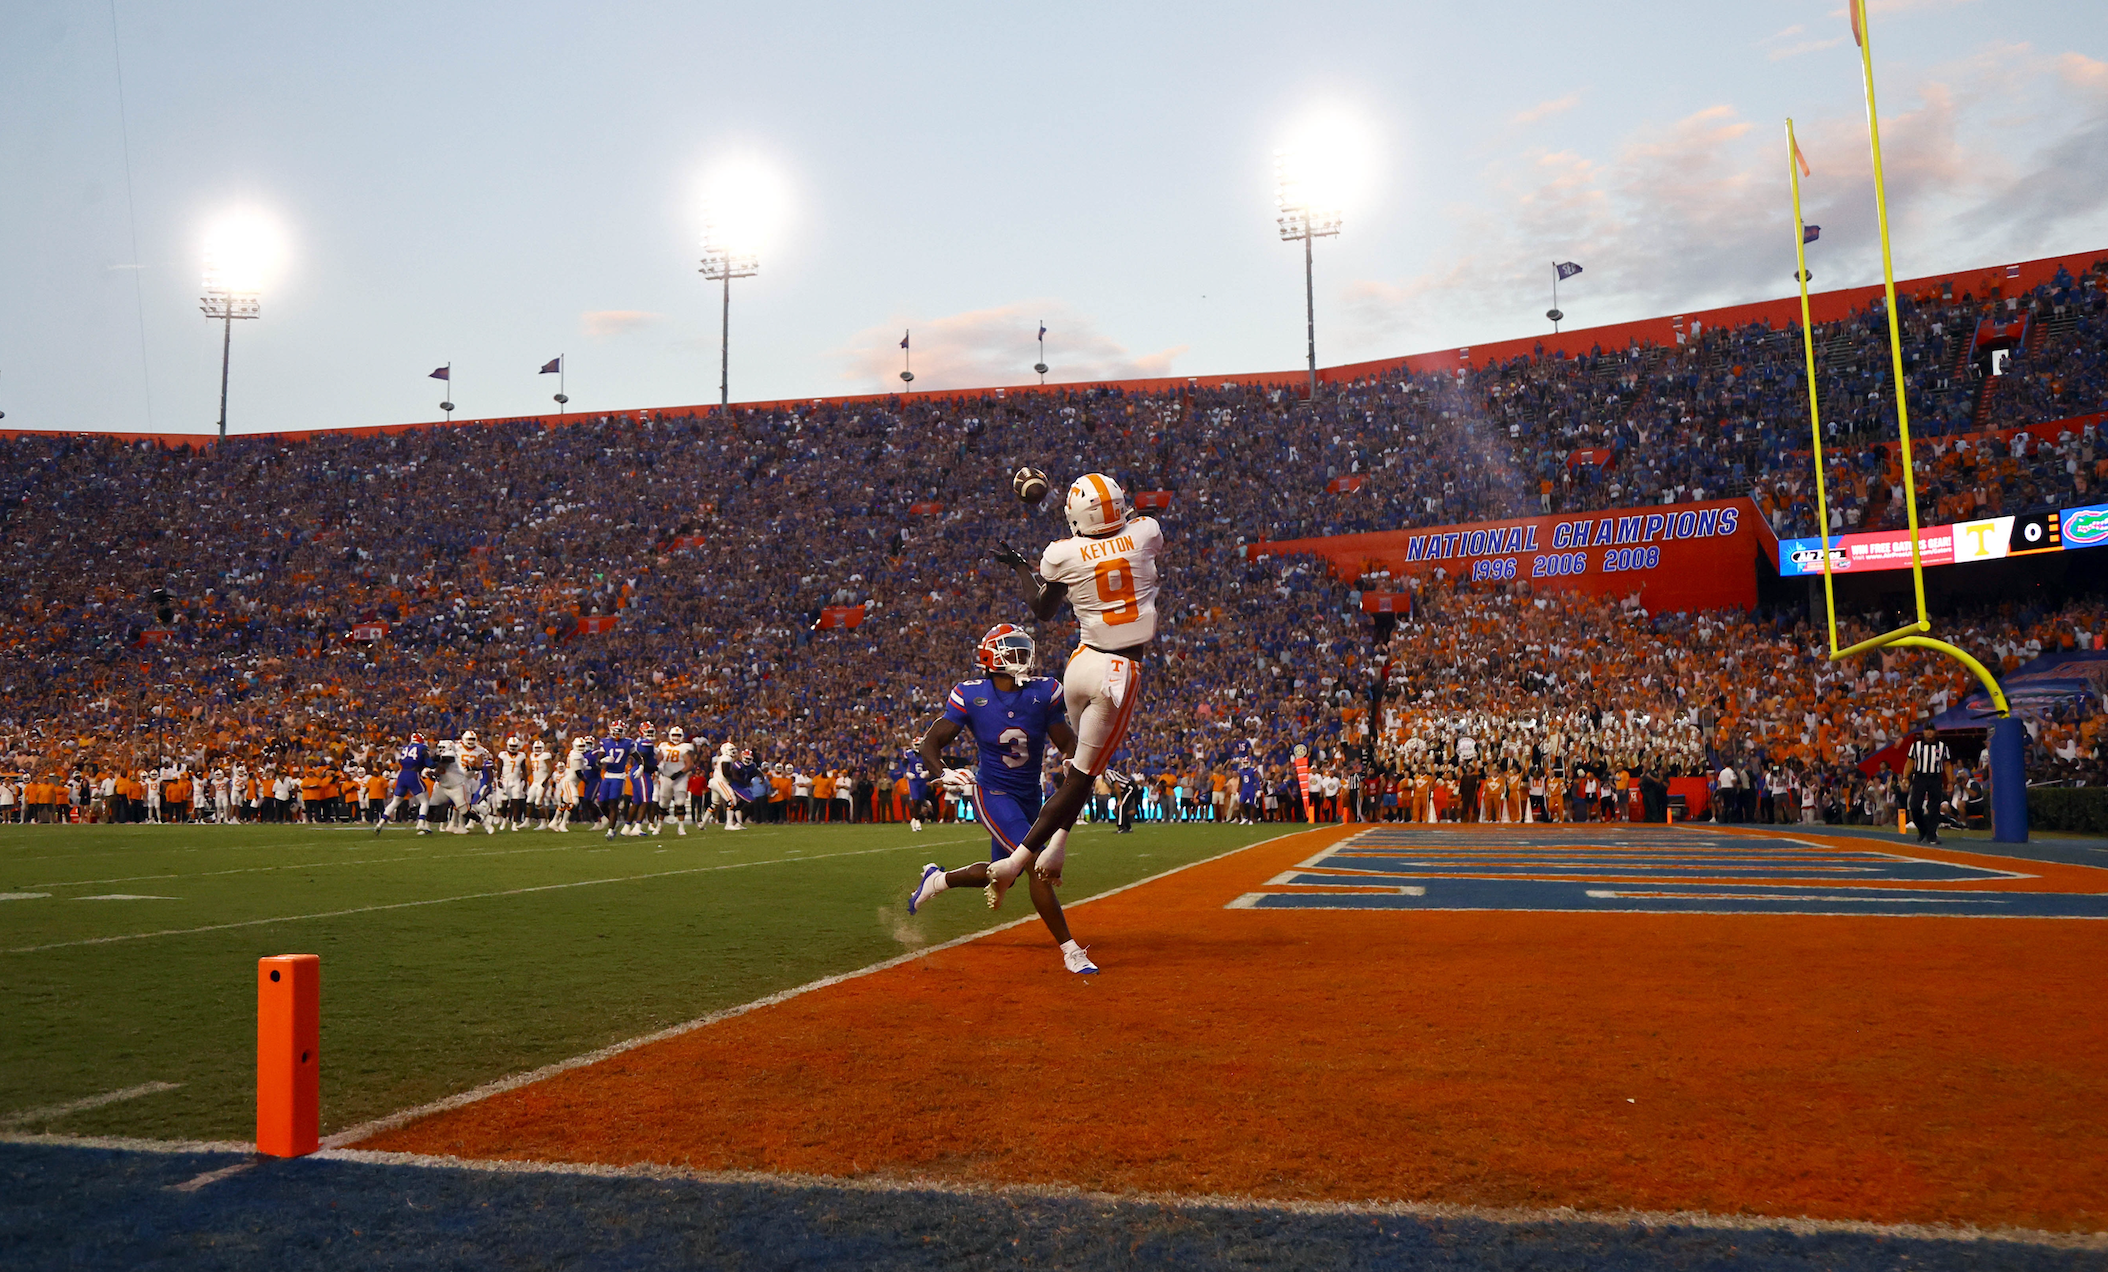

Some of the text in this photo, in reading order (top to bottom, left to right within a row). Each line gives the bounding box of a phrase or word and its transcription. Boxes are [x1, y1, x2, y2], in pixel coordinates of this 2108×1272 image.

[1405, 507, 1739, 562] NATIONAL CHAMPIONS
[1966, 522, 1995, 557] T
[2024, 522, 2042, 542] 0
[1080, 535, 1135, 562] KEYTON
[1851, 543, 1869, 555] WIN
[1870, 541, 1891, 554] FREE
[1892, 538, 1927, 552] GATS
[1472, 545, 1660, 582] 1996 2006 2008
[1094, 557, 1139, 627] 9
[1111, 659, 1124, 673] T
[2080, 694, 2086, 703] 7
[401, 746, 418, 761] 94
[998, 726, 1029, 769] 3
[608, 748, 624, 764] 17
[665, 749, 680, 763] 78
[510, 761, 517, 773] 7
[915, 762, 923, 774] 6
[1243, 775, 1249, 783] 8
[150, 783, 158, 791] 13
[216, 783, 226, 791] 22
